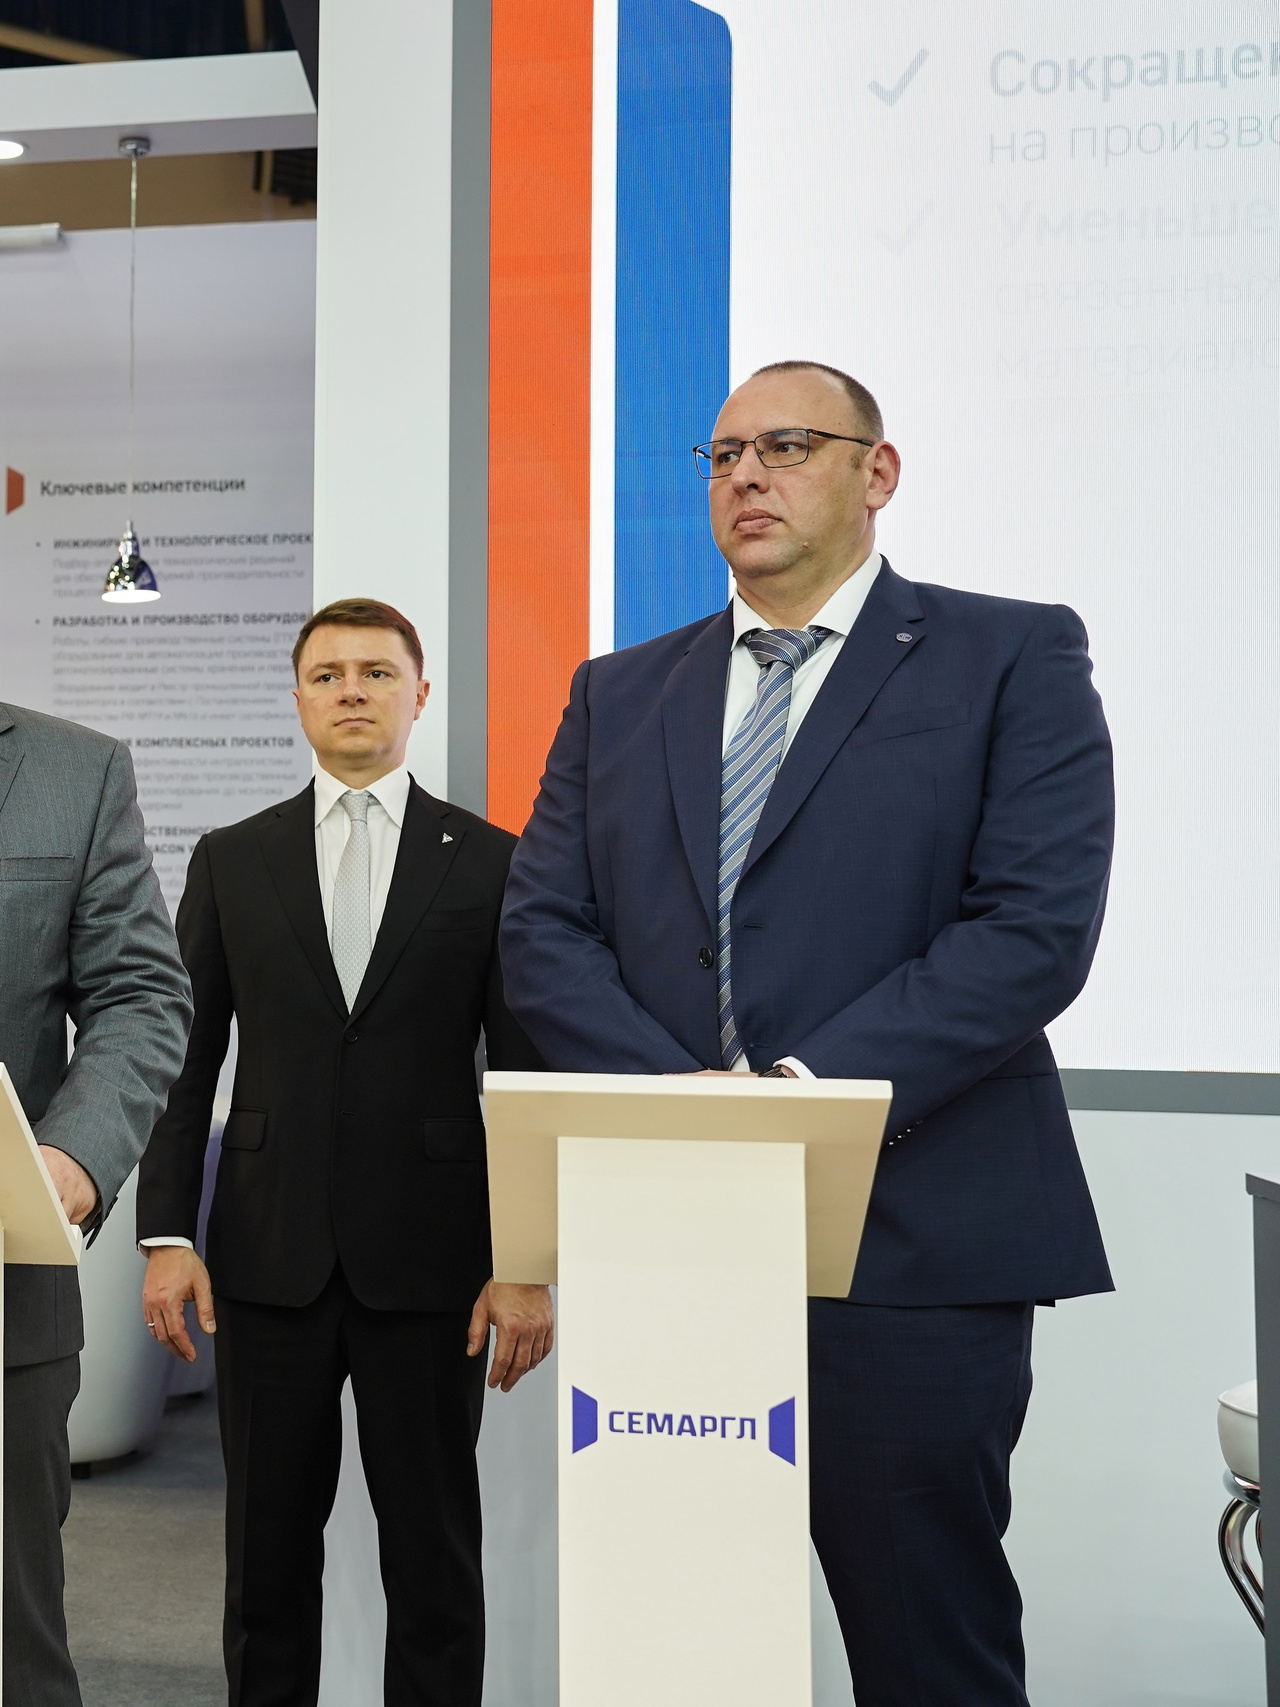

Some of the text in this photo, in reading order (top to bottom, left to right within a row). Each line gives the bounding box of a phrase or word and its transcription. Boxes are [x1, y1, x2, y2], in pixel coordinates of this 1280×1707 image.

[988, 127, 1048, 165] на
[40, 478, 247, 498] Ключевые компетенции
[153, 534, 269, 548] ТЕХНОЛОГИЧЕСКОЕ
[272, 532, 313, 545] ПРОЕК
[52, 615, 128, 627] РАЗРАБОТКА
[131, 614, 140, 626] И
[143, 613, 240, 627] ПРОИЗВОДСТВО
[136, 737, 227, 748] КОМПЛЕКСНЫХ
[231, 736, 294, 747] ПРОЕКТОВ
[609, 1410, 756, 1440] СЕМАРГЛ
